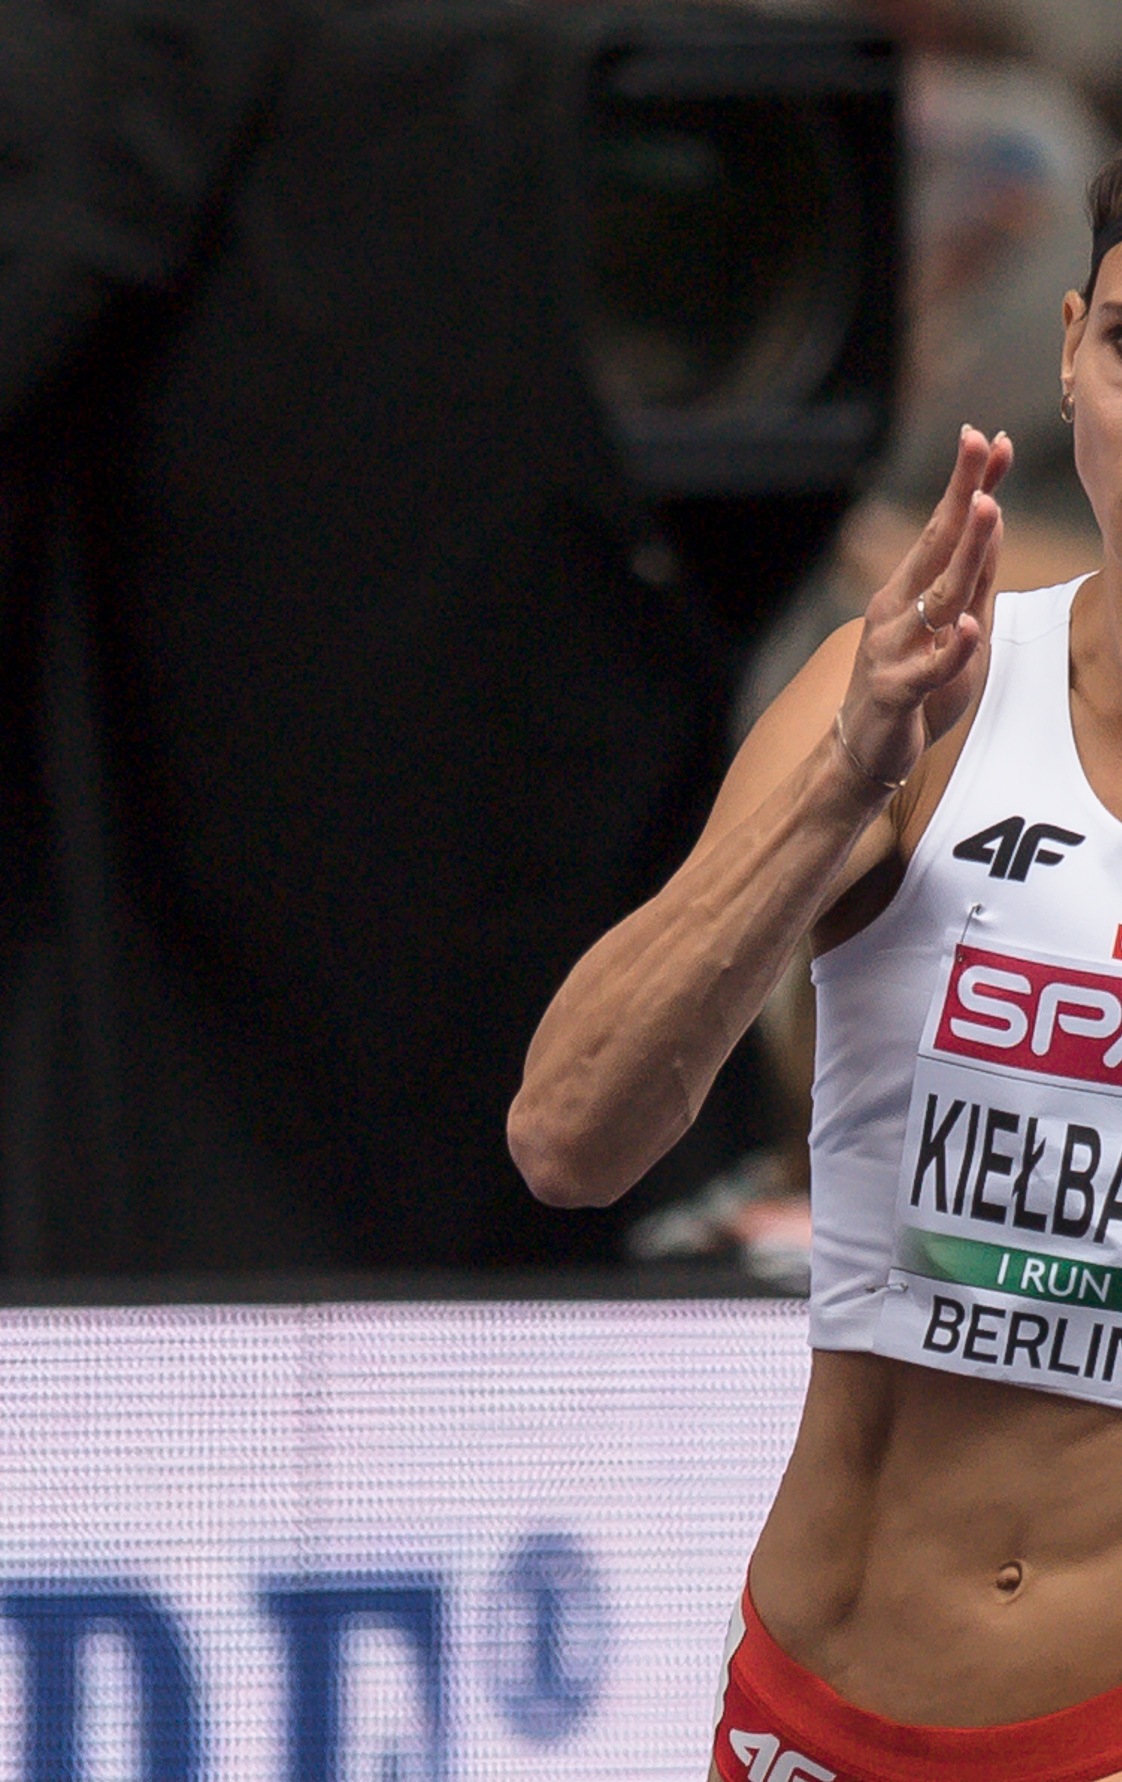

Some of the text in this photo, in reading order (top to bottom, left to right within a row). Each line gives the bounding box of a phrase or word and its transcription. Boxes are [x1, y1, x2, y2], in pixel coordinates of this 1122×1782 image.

[952, 815, 1086, 883] 4F
[996, 1252, 1010, 1286] I
[1020, 1257, 1112, 1303] RUN
